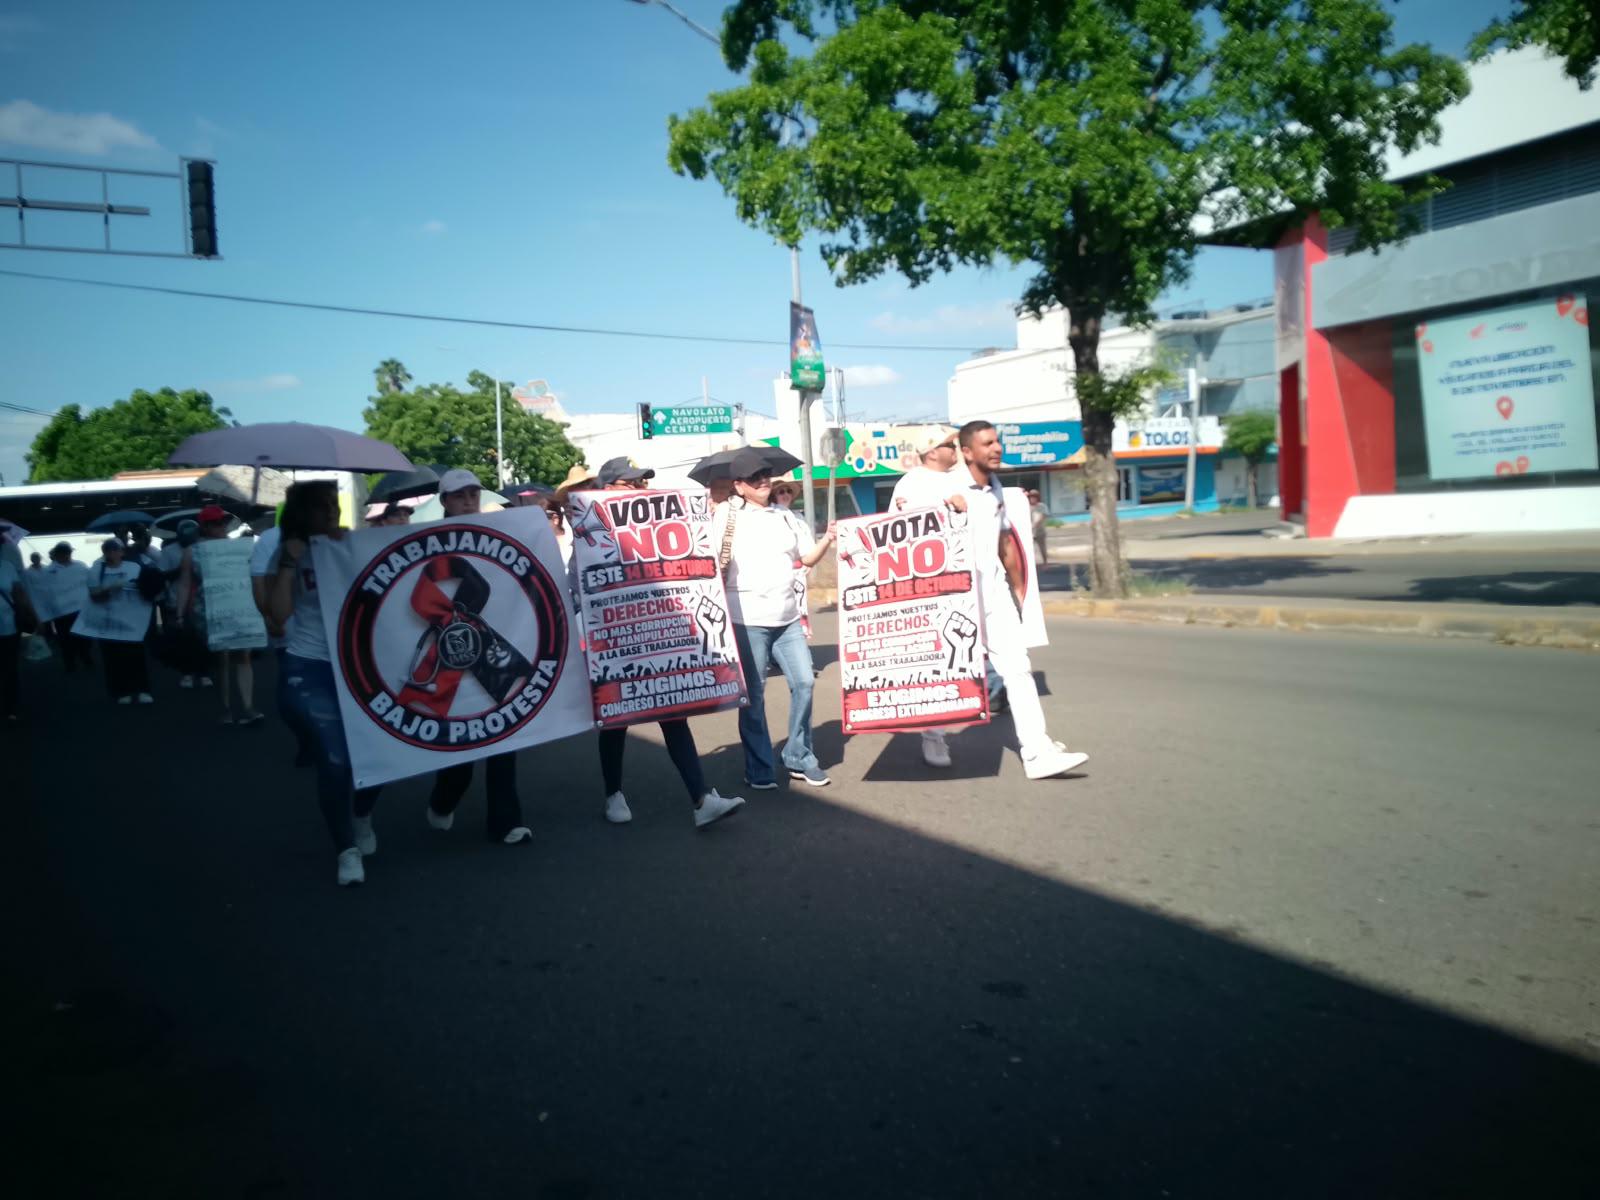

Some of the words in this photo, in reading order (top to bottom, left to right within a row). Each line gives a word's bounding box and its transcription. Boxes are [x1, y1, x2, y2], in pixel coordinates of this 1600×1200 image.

[669, 415, 731, 425] AEROPUERTO
[672, 407, 725, 416] NAVOLATO
[664, 425, 708, 433] CENTRO
[608, 494, 685, 527] VOTA
[616, 523, 692, 562] NO
[871, 511, 941, 548] VOTA
[362, 531, 531, 595] TRABAJAMOS
[877, 538, 946, 581] NO
[586, 565, 624, 588] ESTE
[642, 561, 663, 578] DE
[662, 558, 716, 577] OCTUBRE
[590, 590, 649, 608] PROTEJAMOS
[650, 586, 690, 598] NUESTROS
[847, 608, 898, 623] PROTEJAMOS
[593, 629, 608, 641] NO
[607, 639, 615, 649] Y
[598, 652, 605, 661] A
[606, 650, 618, 660] LA
[619, 645, 643, 657] BASE
[644, 637, 701, 653] TRABAJADORA
[856, 661, 866, 670] LA
[867, 659, 886, 668] BASE
[889, 653, 946, 666] TRABAJADORA
[620, 670, 716, 699] EXIGIMOS
[368, 691, 440, 742] BAJO
[449, 660, 558, 743] PROTESTA
[600, 696, 655, 718] CONGRESO
[655, 681, 739, 708] EXTRAORDINARIO
